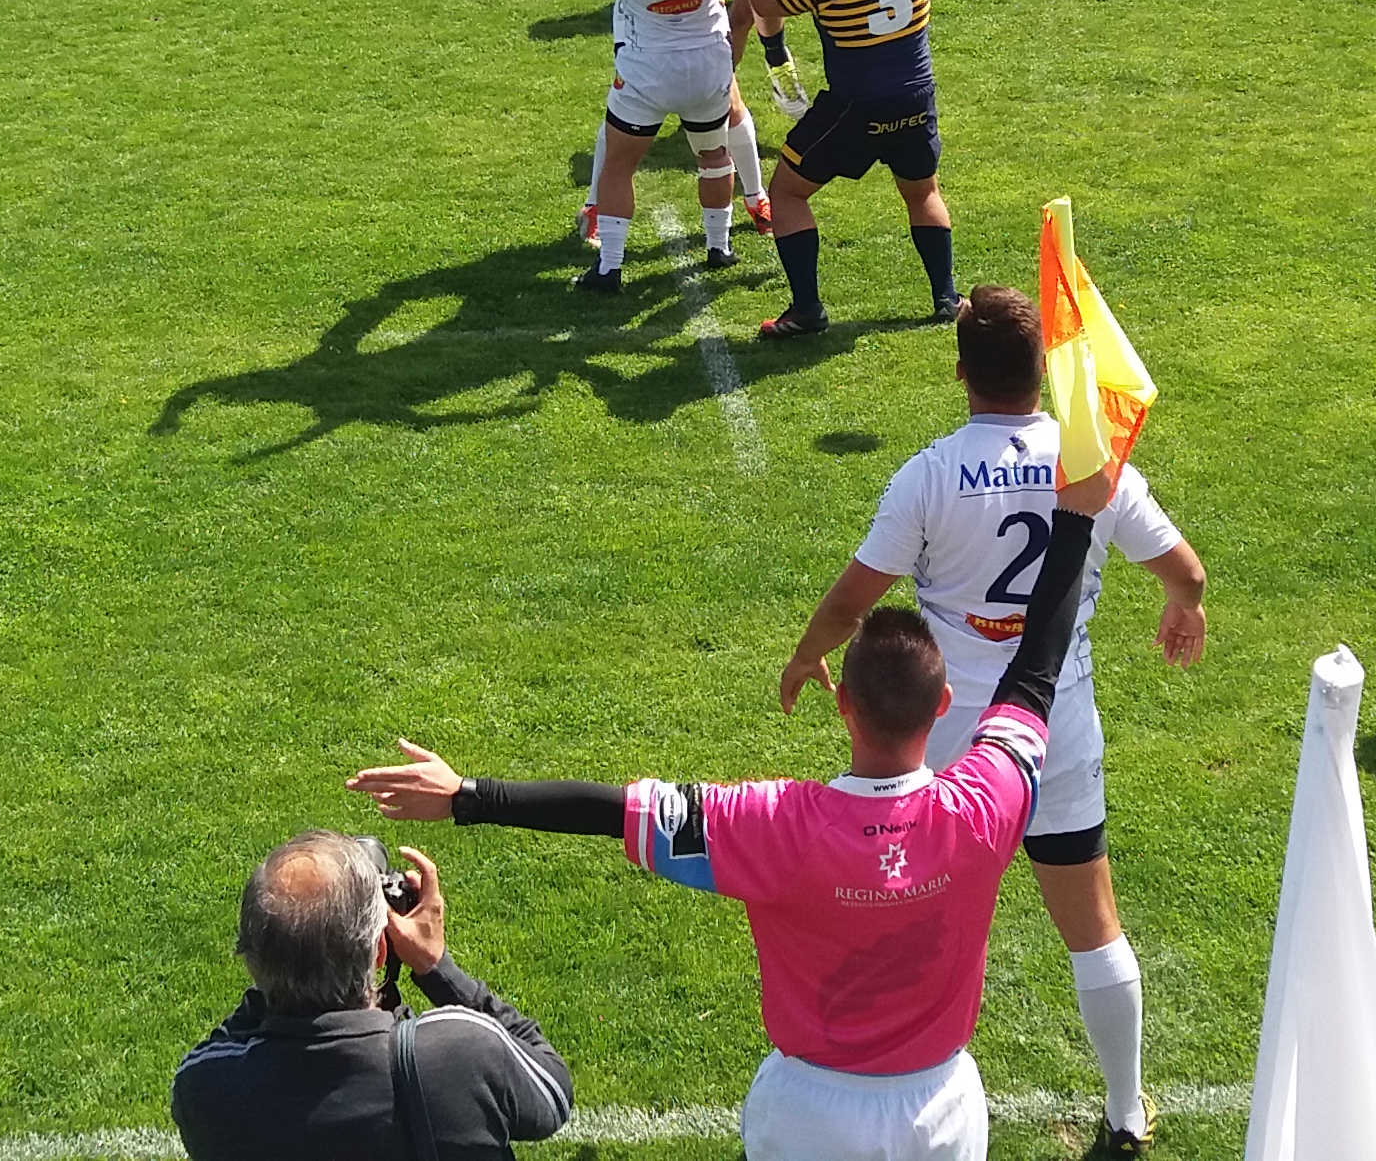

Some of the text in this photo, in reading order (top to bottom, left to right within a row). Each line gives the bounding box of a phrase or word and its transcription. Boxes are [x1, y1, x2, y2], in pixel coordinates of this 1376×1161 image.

[959, 460, 1052, 491] Matm
[985, 511, 1051, 605] 2
[835, 873, 952, 901] REGINA MARIA
